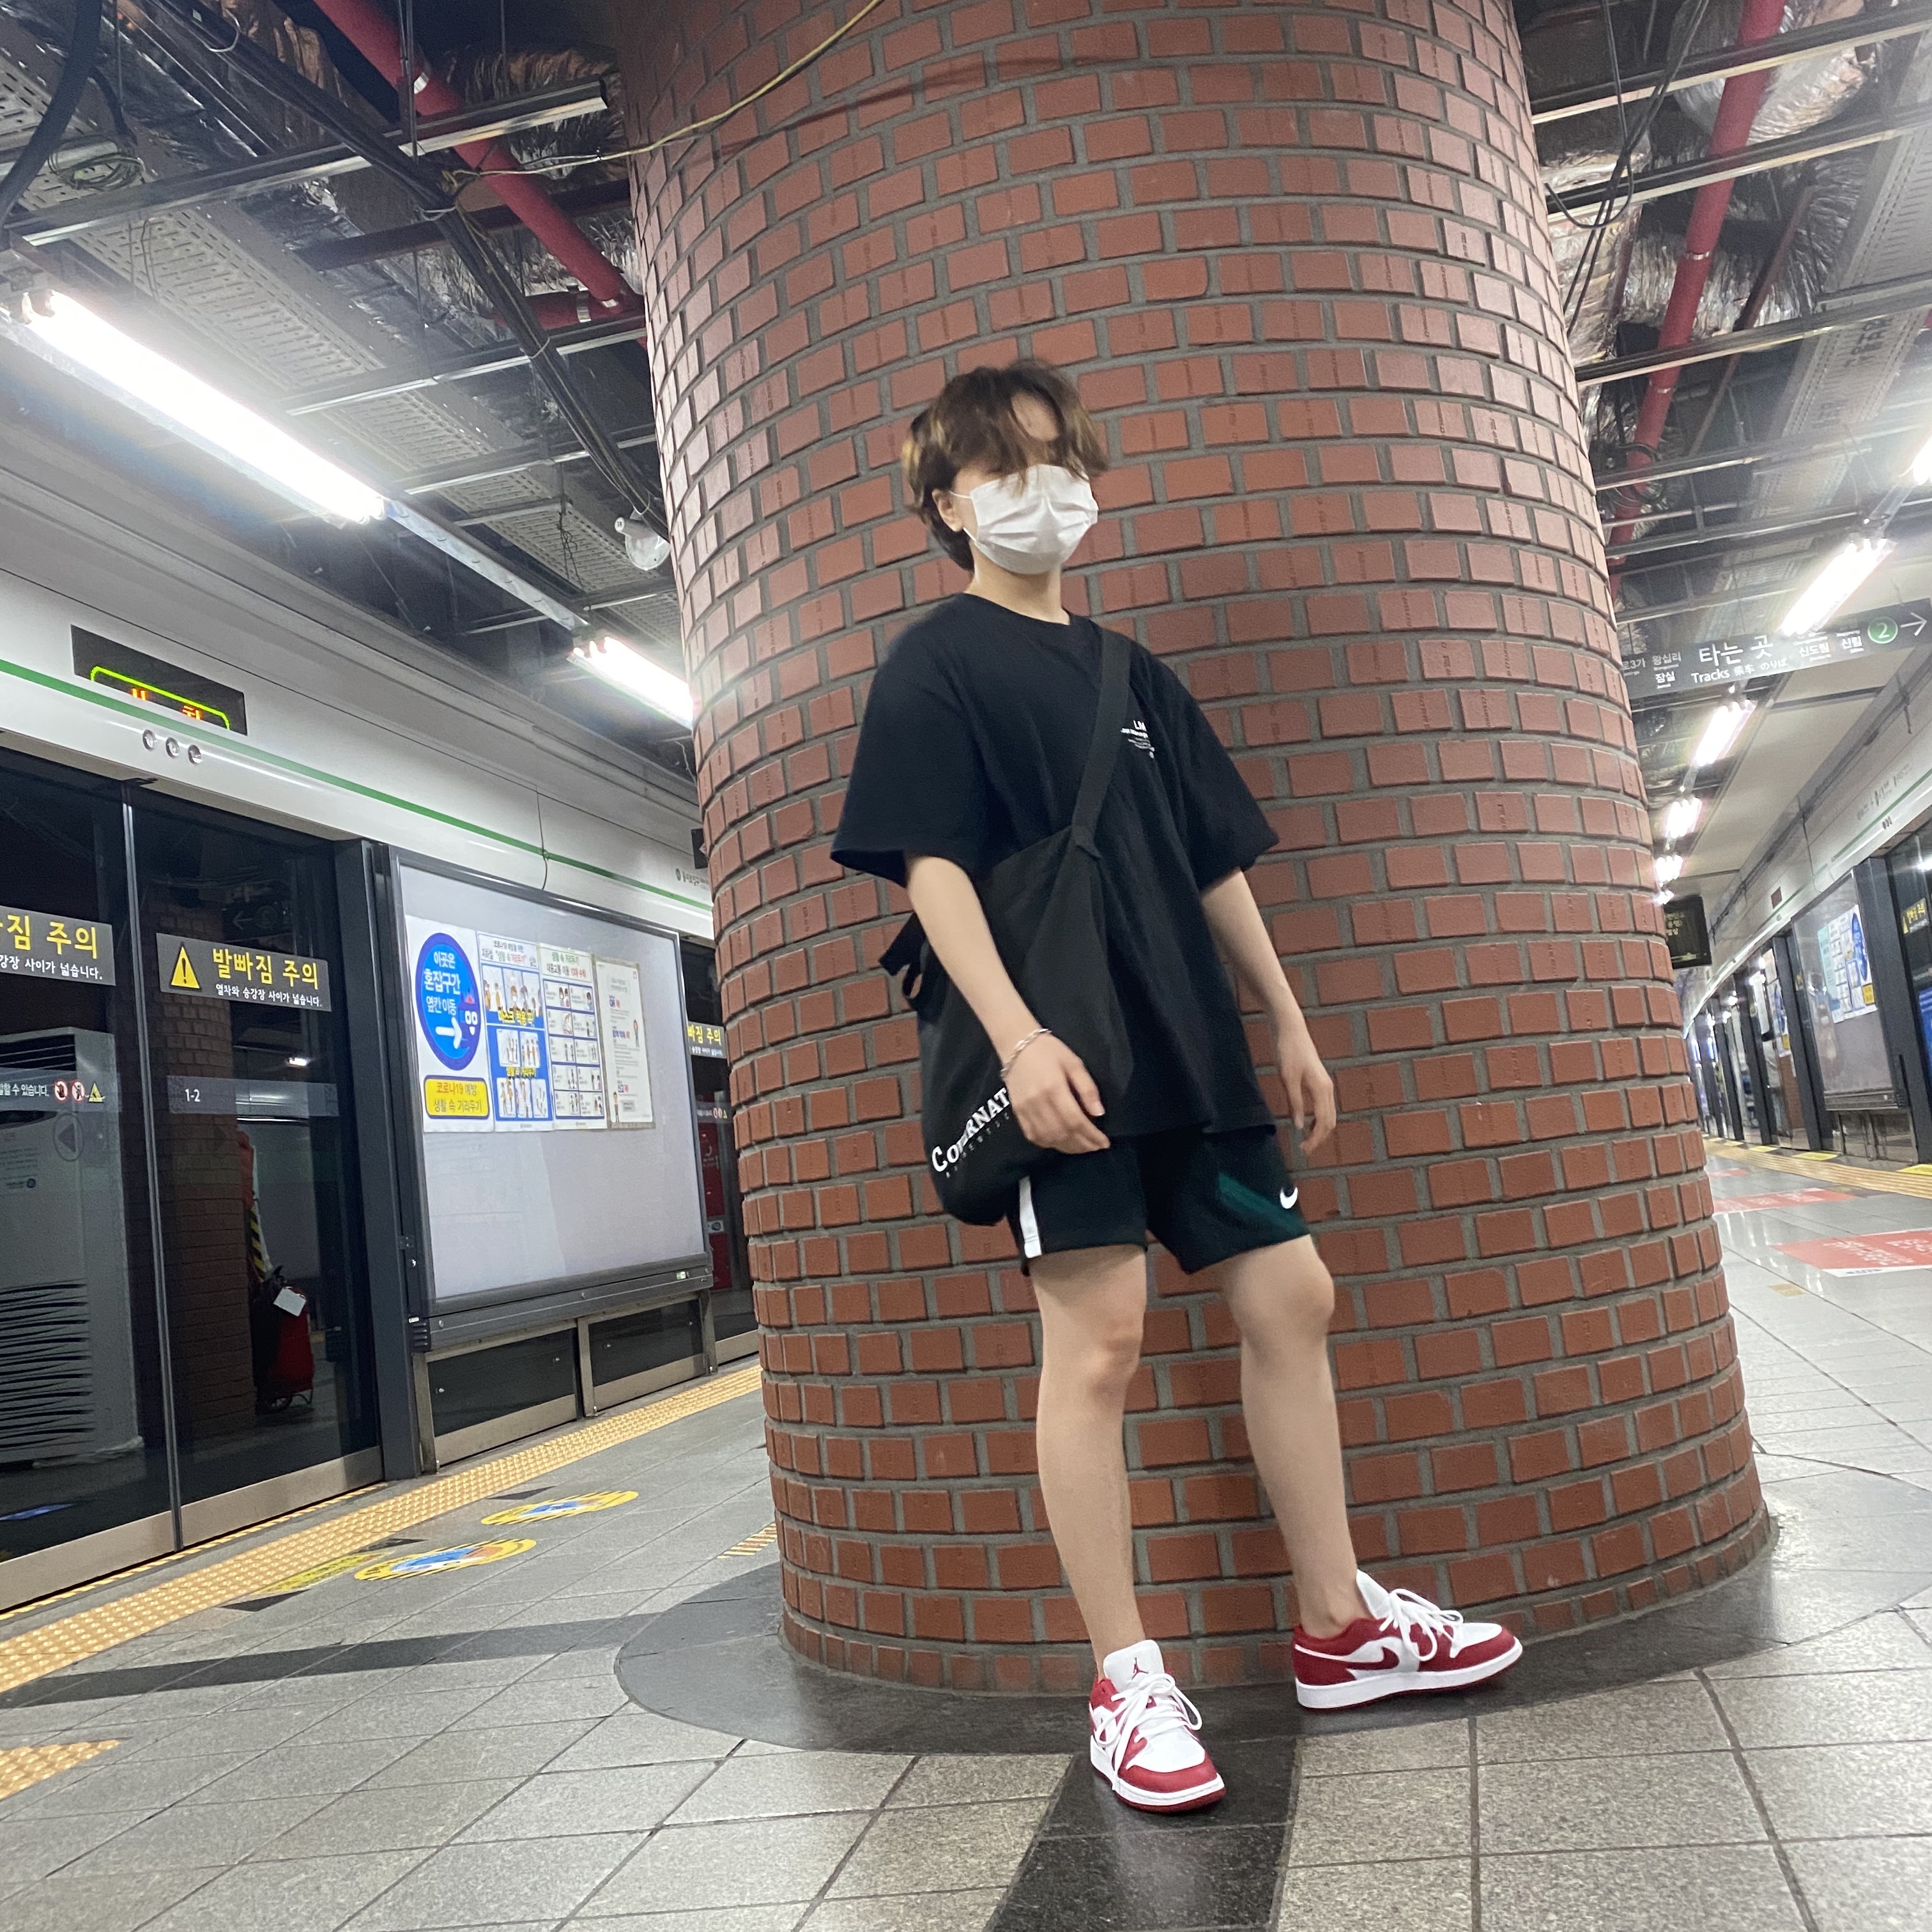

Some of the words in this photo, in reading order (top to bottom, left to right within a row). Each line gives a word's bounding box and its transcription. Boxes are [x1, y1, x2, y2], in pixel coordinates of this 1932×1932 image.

[1652, 652, 1682, 666] 왕십리
[1699, 641, 1744, 666] 타는
[1751, 634, 1774, 659] 곳
[1655, 671, 1676, 684] 잠실
[1691, 668, 1731, 684] Tracks
[0, 914, 31, 951] 짐
[47, 921, 97, 960] 주의
[25, 958, 56, 974] 사이가
[60, 962, 103, 980] 넓습니다.
[213, 948, 273, 985] 발빠짐
[282, 959, 318, 990] 주의
[433, 951, 456, 969] 이곳은
[424, 968, 461, 995] 혼잡구간
[215, 983, 240, 997] 열차와
[242, 986, 266, 1000] 승강장
[268, 990, 290, 1003] 사이가
[292, 993, 323, 1007] 넓습니다.
[426, 995, 442, 1013] 옆칸
[442, 998, 456, 1016] 이동
[706, 1027, 722, 1046] 주의
[12, 1083, 20, 1096] 수
[20, 1084, 50, 1098] 있습니다.
[185, 1088, 201, 1103] 1-2
[436, 1082, 464, 1095] 코로나19
[465, 1083, 477, 1096] 예방
[434, 1098, 447, 1112] 생활
[448, 1099, 456, 1112] 속
[457, 1100, 482, 1112] 거리두기
